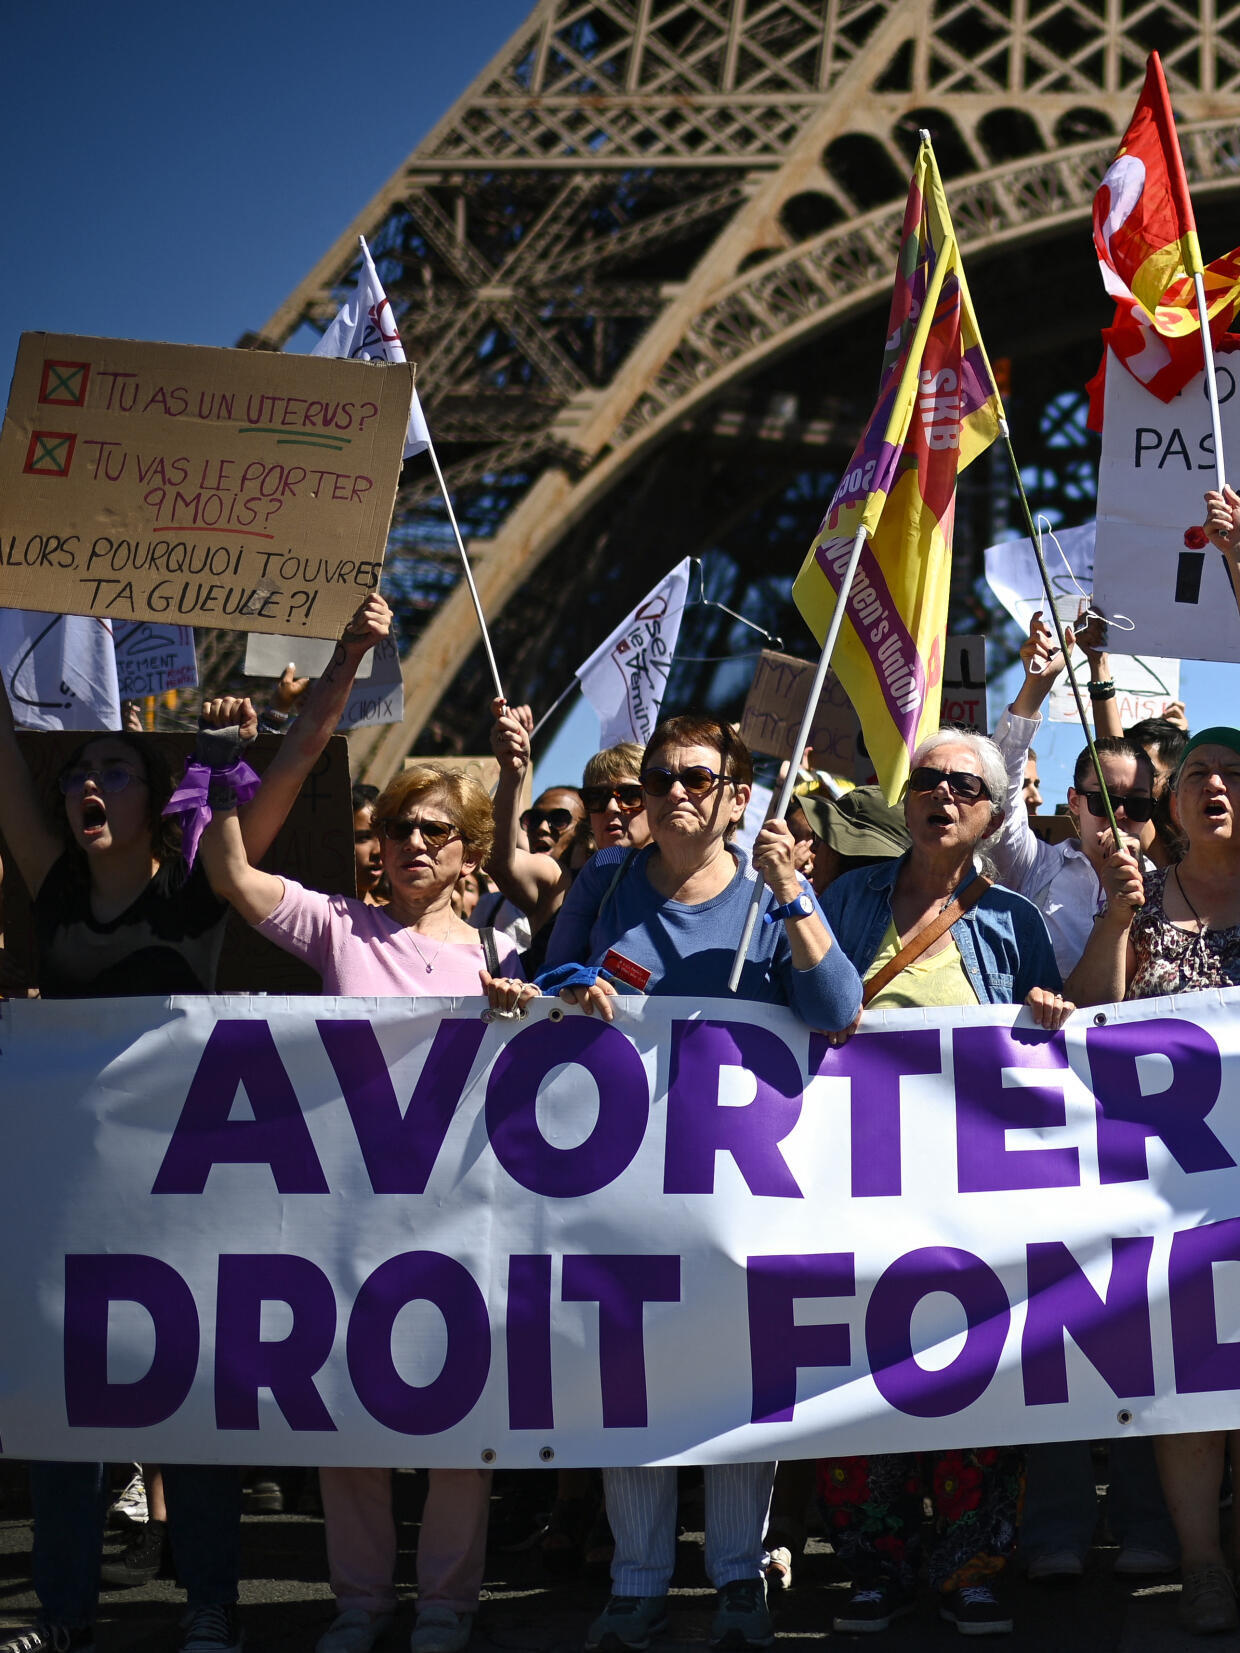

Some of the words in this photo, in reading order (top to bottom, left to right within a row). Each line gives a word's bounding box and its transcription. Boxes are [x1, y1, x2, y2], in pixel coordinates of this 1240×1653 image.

[97, 372, 139, 412] TU
[145, 387, 189, 418] AS
[200, 392, 236, 420] UN
[246, 394, 378, 431] UTERUS?
[918, 367, 961, 450] SKB
[83, 440, 127, 481] TU
[135, 455, 189, 487] VAS
[200, 459, 236, 492] LE
[241, 461, 373, 503] PORTER
[1135, 427, 1216, 470] PAS
[144, 487, 166, 521] 9
[0, 534, 80, 571] LORS,
[80, 577, 135, 613] TA
[820, 536, 890, 643] Women's
[877, 633, 922, 715] Union
[150, 1017, 1238, 1199] AVORTER
[64, 1250, 681, 1436] DROIT
